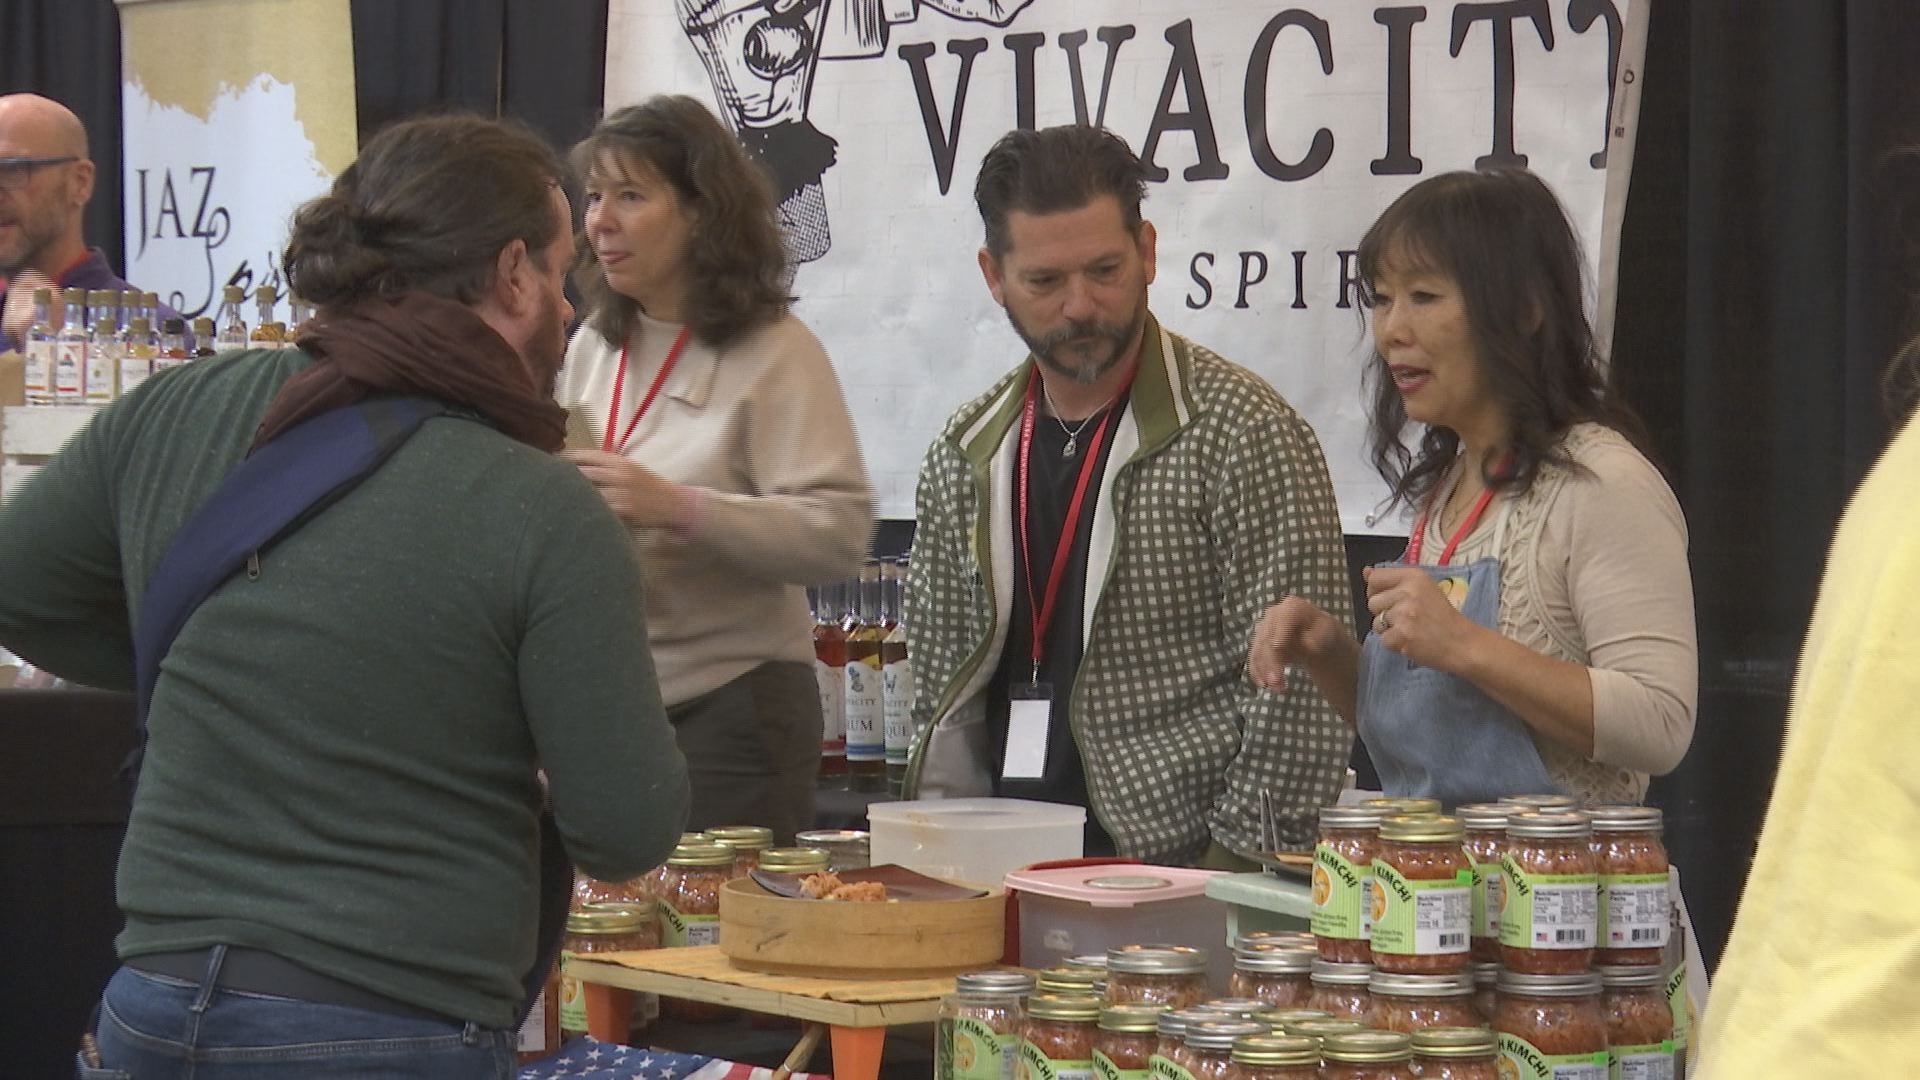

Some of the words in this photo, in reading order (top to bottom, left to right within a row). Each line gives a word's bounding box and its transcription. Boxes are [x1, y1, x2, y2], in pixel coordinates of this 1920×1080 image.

[135, 166, 217, 262] JAZ
[1320, 850, 1359, 889] KIMCHI
[1376, 865, 1413, 904] KIMCHI
[1506, 1039, 1549, 1079] KIMCHI
